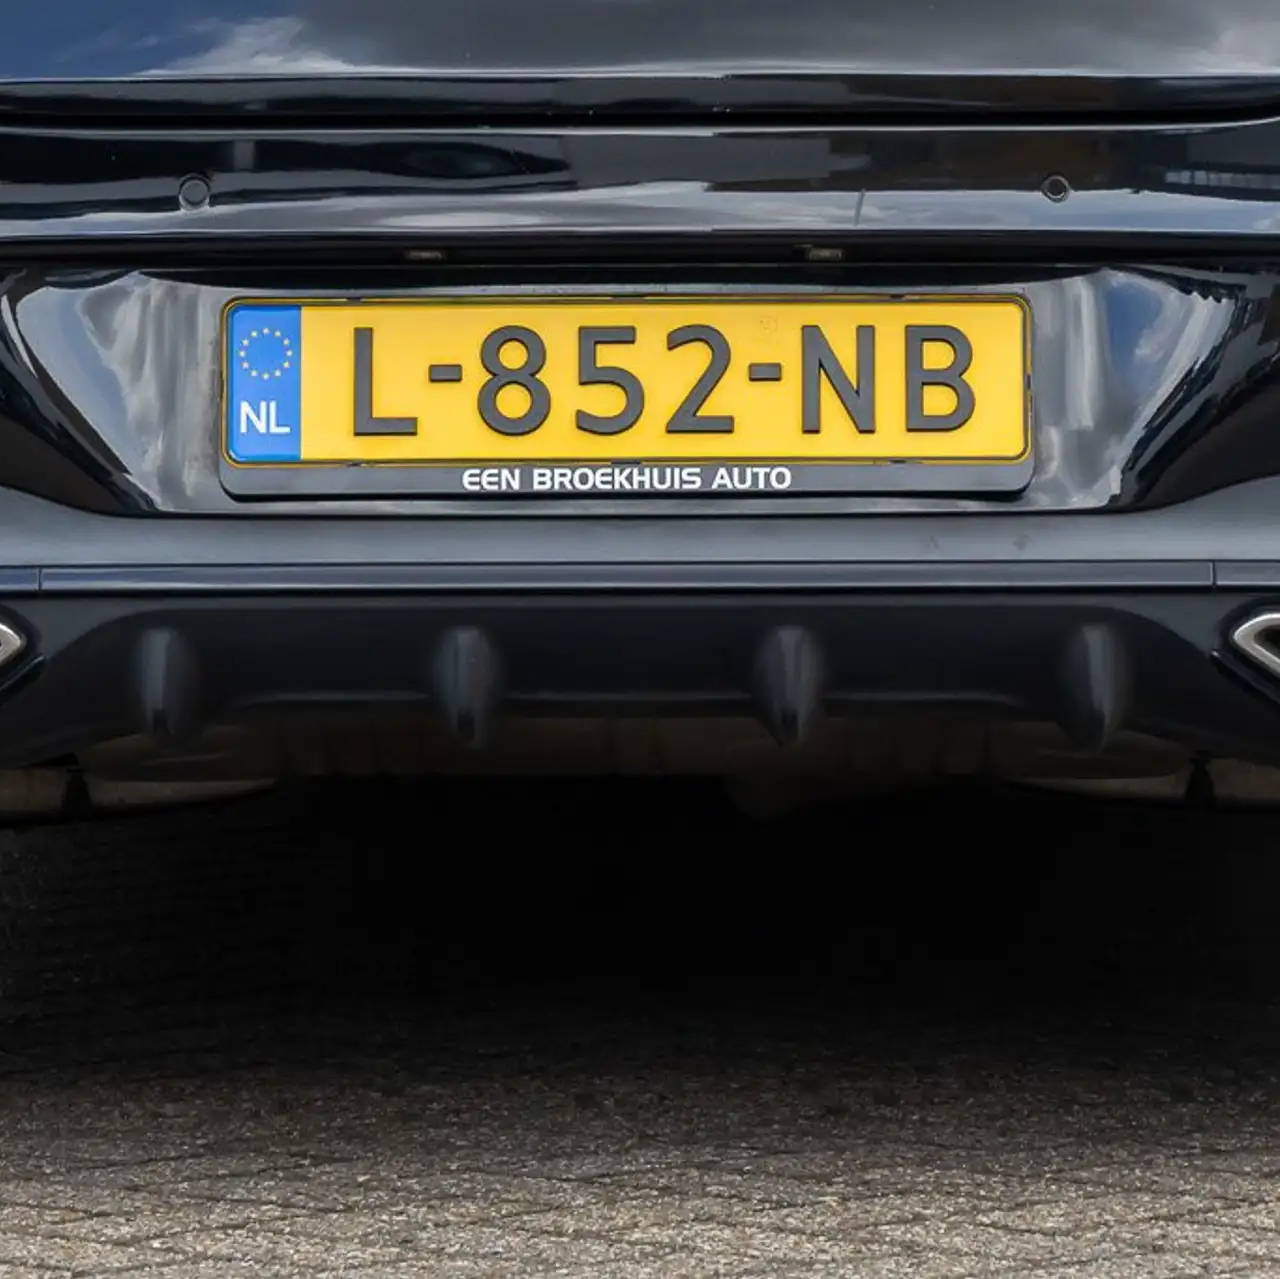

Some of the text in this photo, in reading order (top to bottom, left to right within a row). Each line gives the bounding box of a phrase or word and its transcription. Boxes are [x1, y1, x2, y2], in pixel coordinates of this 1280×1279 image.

[353, 323, 976, 437] L-852-NB
[239, 400, 291, 434] NL
[461, 466, 792, 492] EEN BROEKHUIS AUTO
